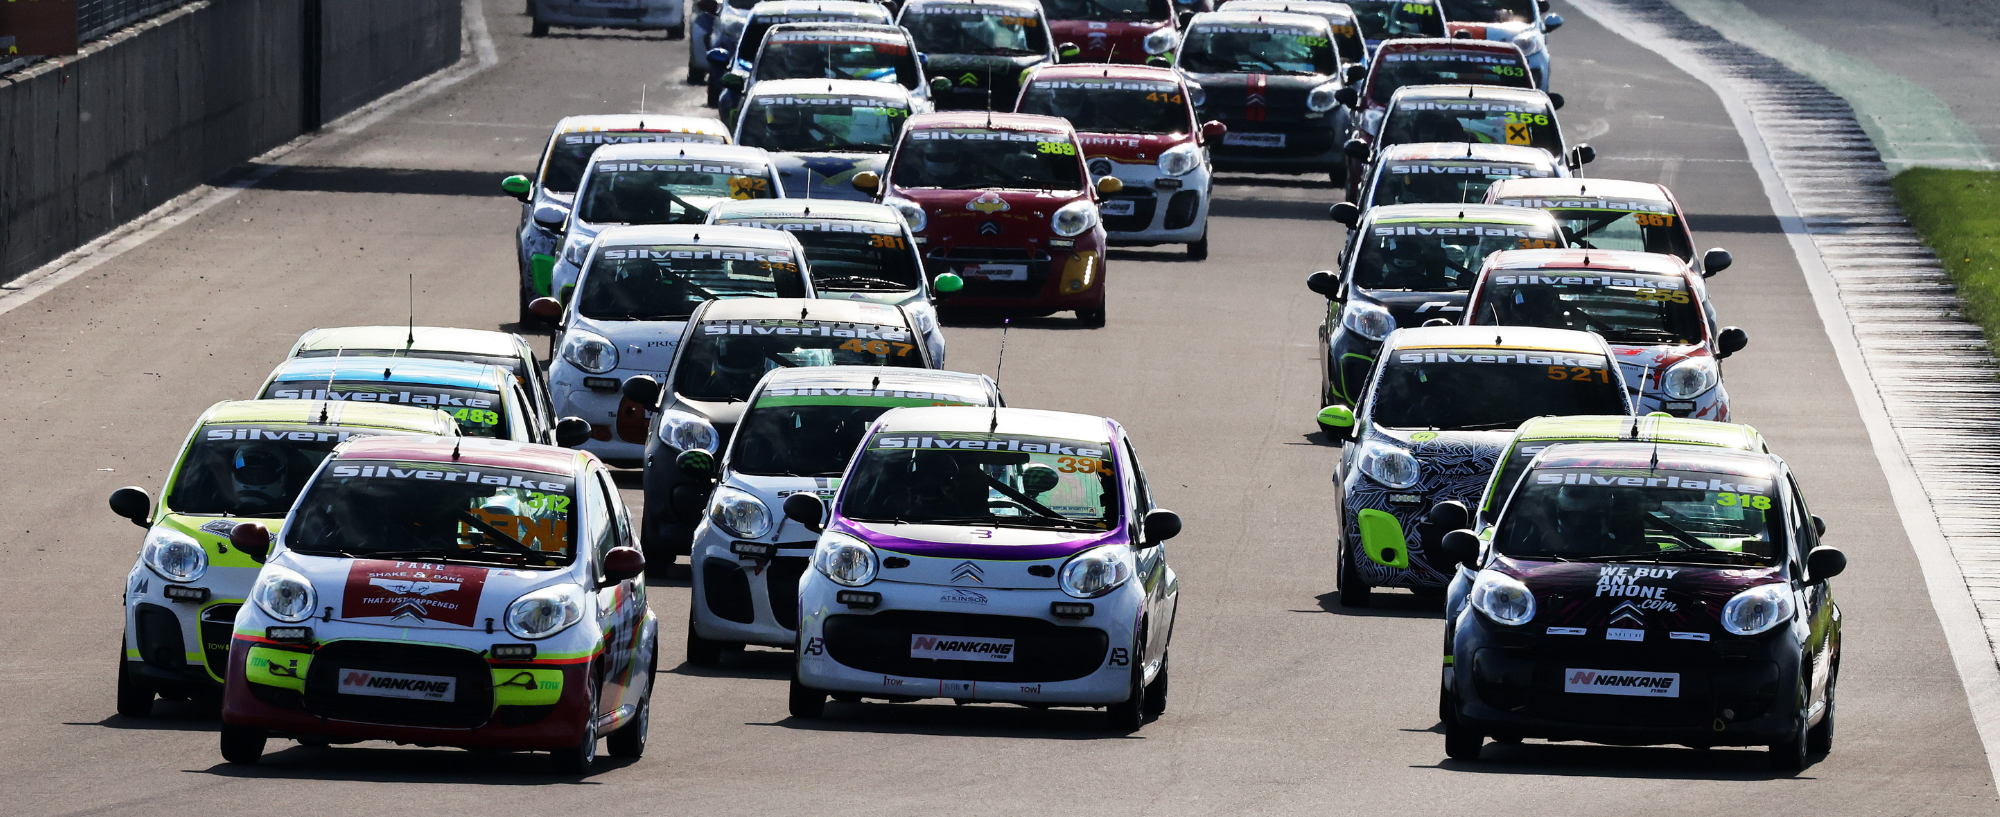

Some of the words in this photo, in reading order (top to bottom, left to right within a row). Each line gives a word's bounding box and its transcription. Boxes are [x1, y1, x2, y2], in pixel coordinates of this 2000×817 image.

[1034, 81, 1175, 92] Silverlake
[759, 97, 904, 108] Silverlake
[1146, 92, 1182, 105] 414
[1400, 102, 1542, 114] Silverlake
[1504, 112, 1549, 126] 356
[911, 131, 1068, 143] Silverlake
[599, 163, 762, 176] Silverlake
[1392, 165, 1549, 178] Silverlake
[1502, 199, 1669, 213] Silverlake
[1633, 213, 1674, 227] 367
[1374, 226, 1548, 239] Silverlake
[871, 234, 905, 250] 381
[604, 249, 790, 263] Silverlake
[758, 260, 799, 273] 345
[1496, 275, 1679, 290] Silverlake
[1635, 288, 1690, 304] 555
[704, 323, 905, 343] Silverlake
[839, 338, 915, 357] 467
[1400, 352, 1603, 369] Silverlake
[1547, 366, 1609, 384] 521
[273, 388, 492, 409] Silverlake
[454, 408, 498, 426] 483
[207, 428, 350, 442] Silverl
[879, 436, 1103, 458] Silverlake
[333, 464, 567, 493] Silverlake
[1537, 472, 1765, 494] Silverlake
[528, 491, 571, 514] 312
[1716, 492, 1771, 511] 318
[1600, 566, 1630, 577] WE
[1634, 567, 1680, 580] BUY
[1596, 575, 1641, 586] ANY
[940, 595, 988, 604] ATKINSON
[1595, 584, 1668, 601] PHONE
[1637, 599, 1679, 613] .com
[207, 642, 225, 650] TOW
[935, 640, 1014, 655] NANKANG
[366, 676, 450, 693] NANKANG
[539, 680, 561, 691] TOW
[886, 678, 904, 686] TOW
[1594, 674, 1674, 689] NANKANG
[1020, 686, 1037, 694] TOW
